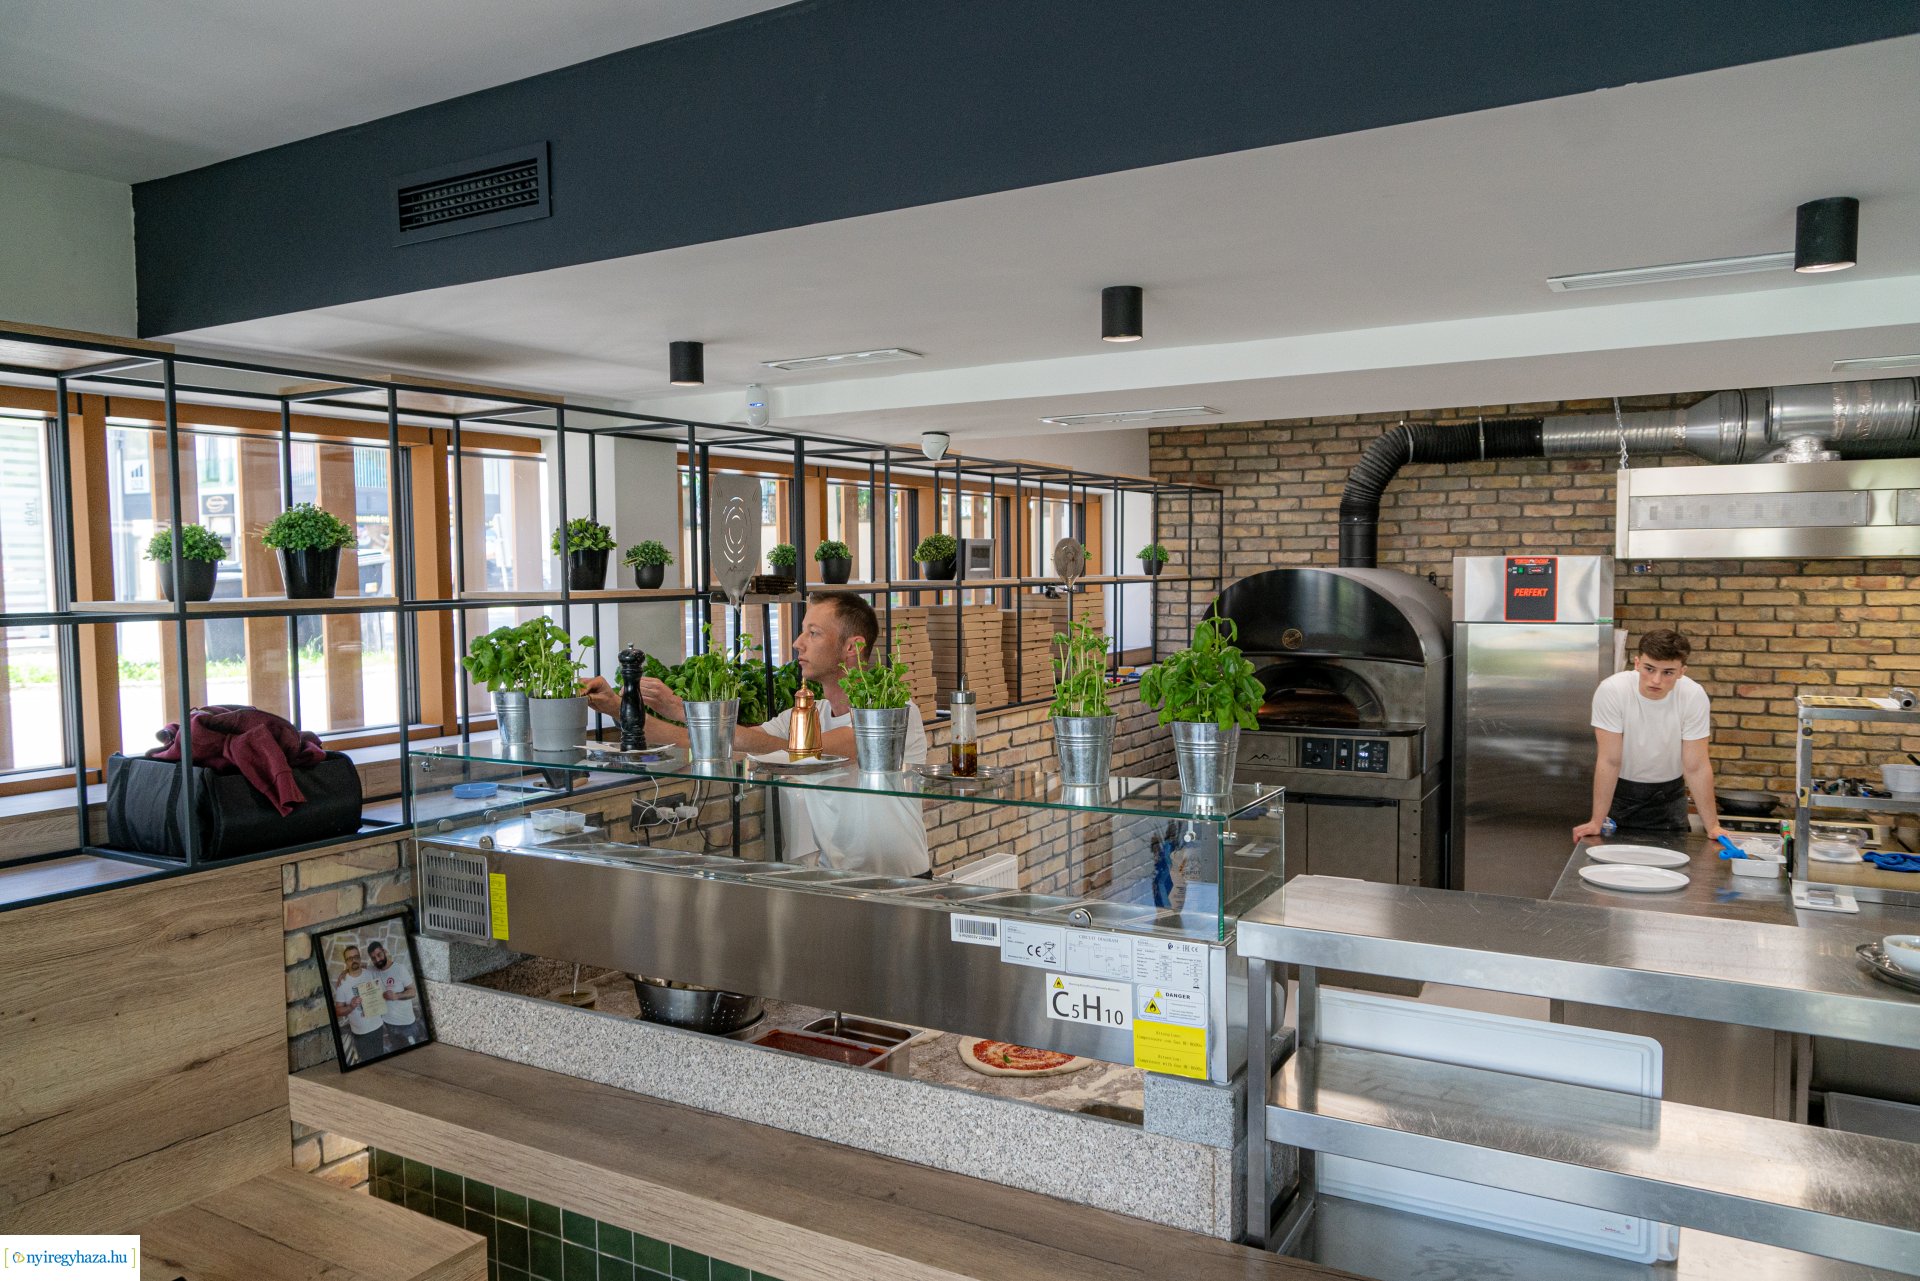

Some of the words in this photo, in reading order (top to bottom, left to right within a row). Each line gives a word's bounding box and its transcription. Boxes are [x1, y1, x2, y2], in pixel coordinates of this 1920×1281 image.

[1514, 588, 1549, 597] PERFEKT
[1027, 944, 1042, 958] CE
[1165, 992, 1191, 1000] DANGER
